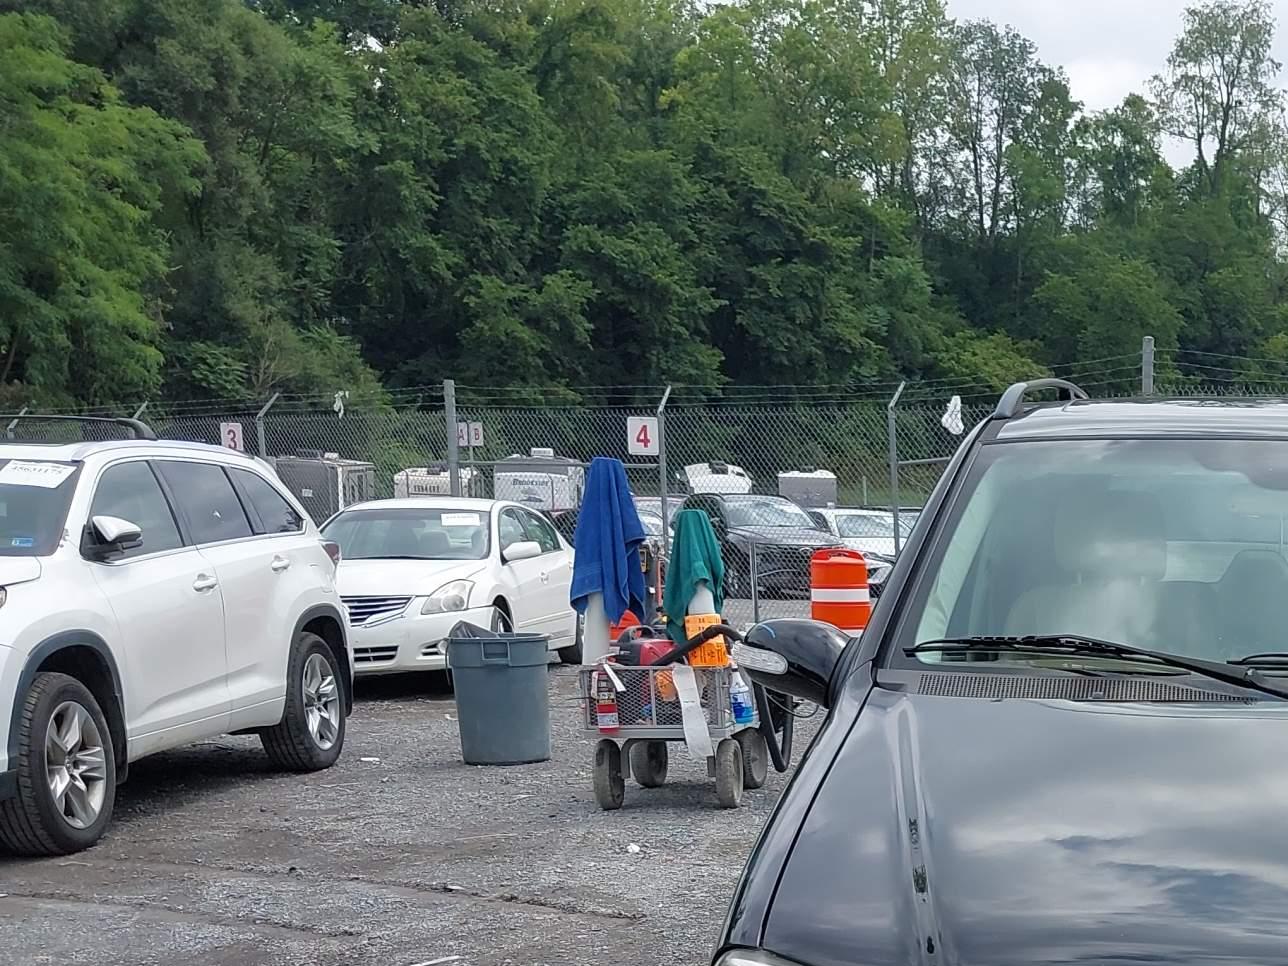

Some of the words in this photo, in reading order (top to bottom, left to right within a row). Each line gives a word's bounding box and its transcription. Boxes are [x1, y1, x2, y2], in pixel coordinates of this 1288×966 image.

[227, 428, 238, 449] 3
[457, 428, 465, 441] A
[474, 427, 480, 441] B
[636, 424, 651, 449] 4
